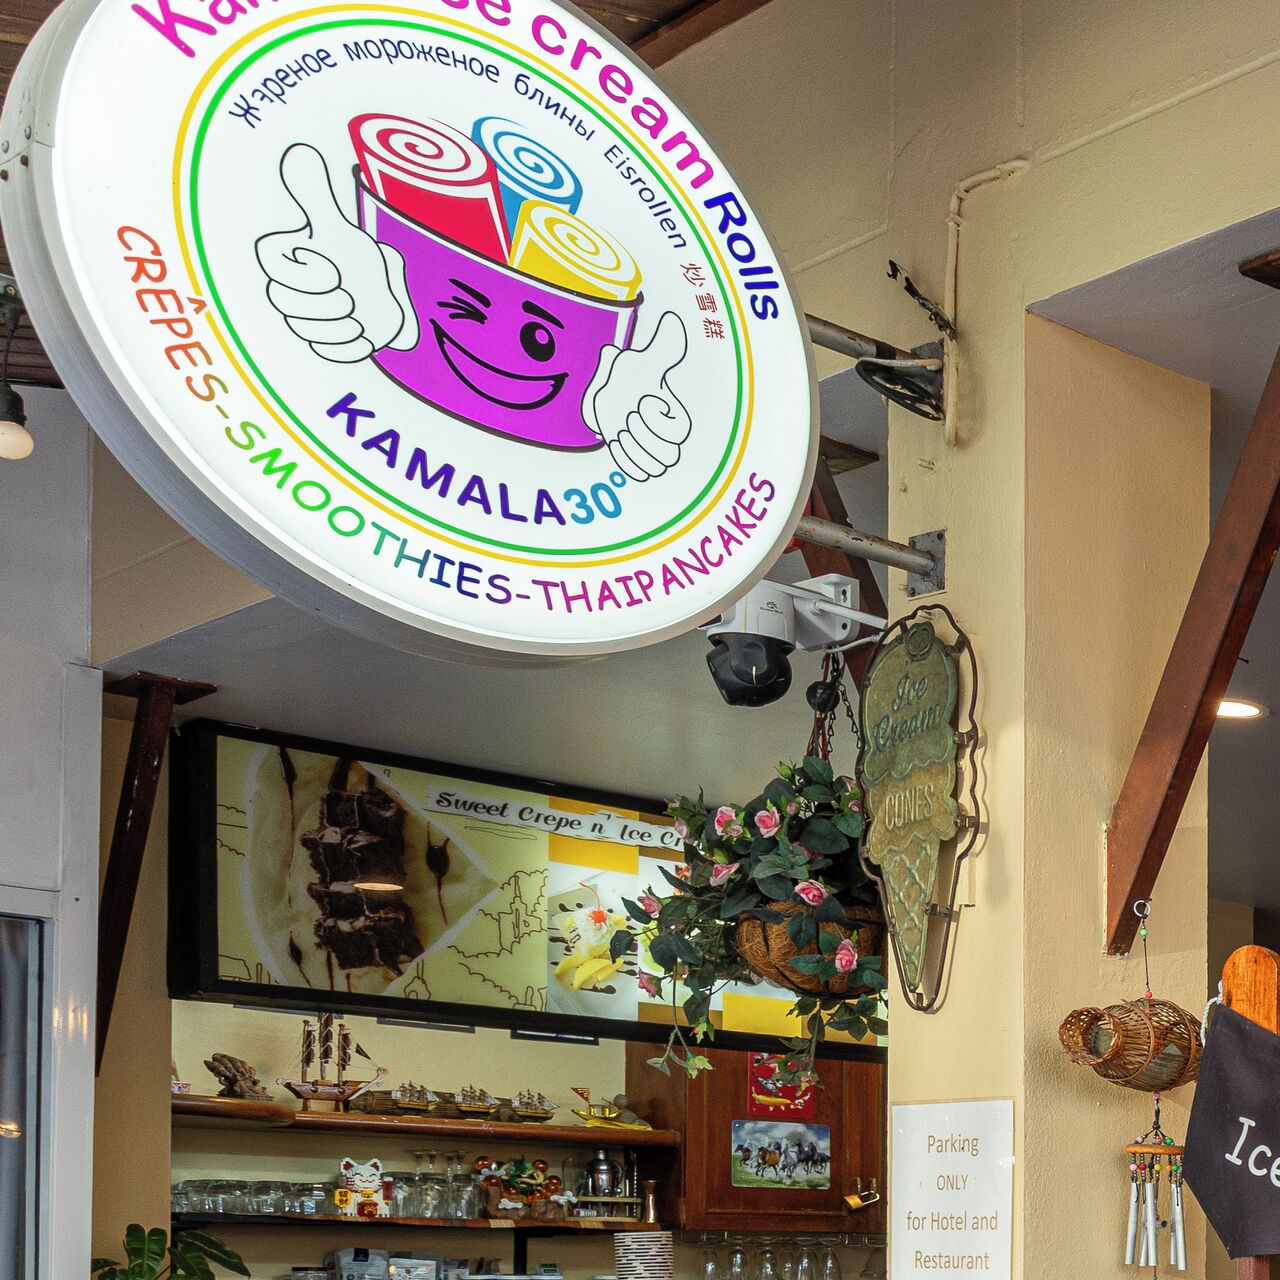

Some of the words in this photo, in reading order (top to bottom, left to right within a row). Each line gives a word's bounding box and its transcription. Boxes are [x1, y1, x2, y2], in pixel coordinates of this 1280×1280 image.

[343, 38, 500, 83] мороженое
[514, 73, 596, 141] блины
[531, 14, 714, 189] cream
[703, 191, 780, 321] Rolls
[603, 144, 688, 249] Eisrollen
[680, 262, 726, 340] 炒雪糕
[892, 673, 928, 713] Ice
[874, 703, 942, 753] Cream
[435, 792, 510, 818] Sweet
[518, 806, 583, 831] Crepe
[619, 823, 653, 842] Ice
[927, 1134, 980, 1157] Parking
[936, 1174, 969, 1191] ONLY
[906, 1211, 927, 1231] for
[931, 1211, 968, 1231] Hotel
[972, 1211, 999, 1231] and
[914, 1250, 990, 1270] Restaurant
